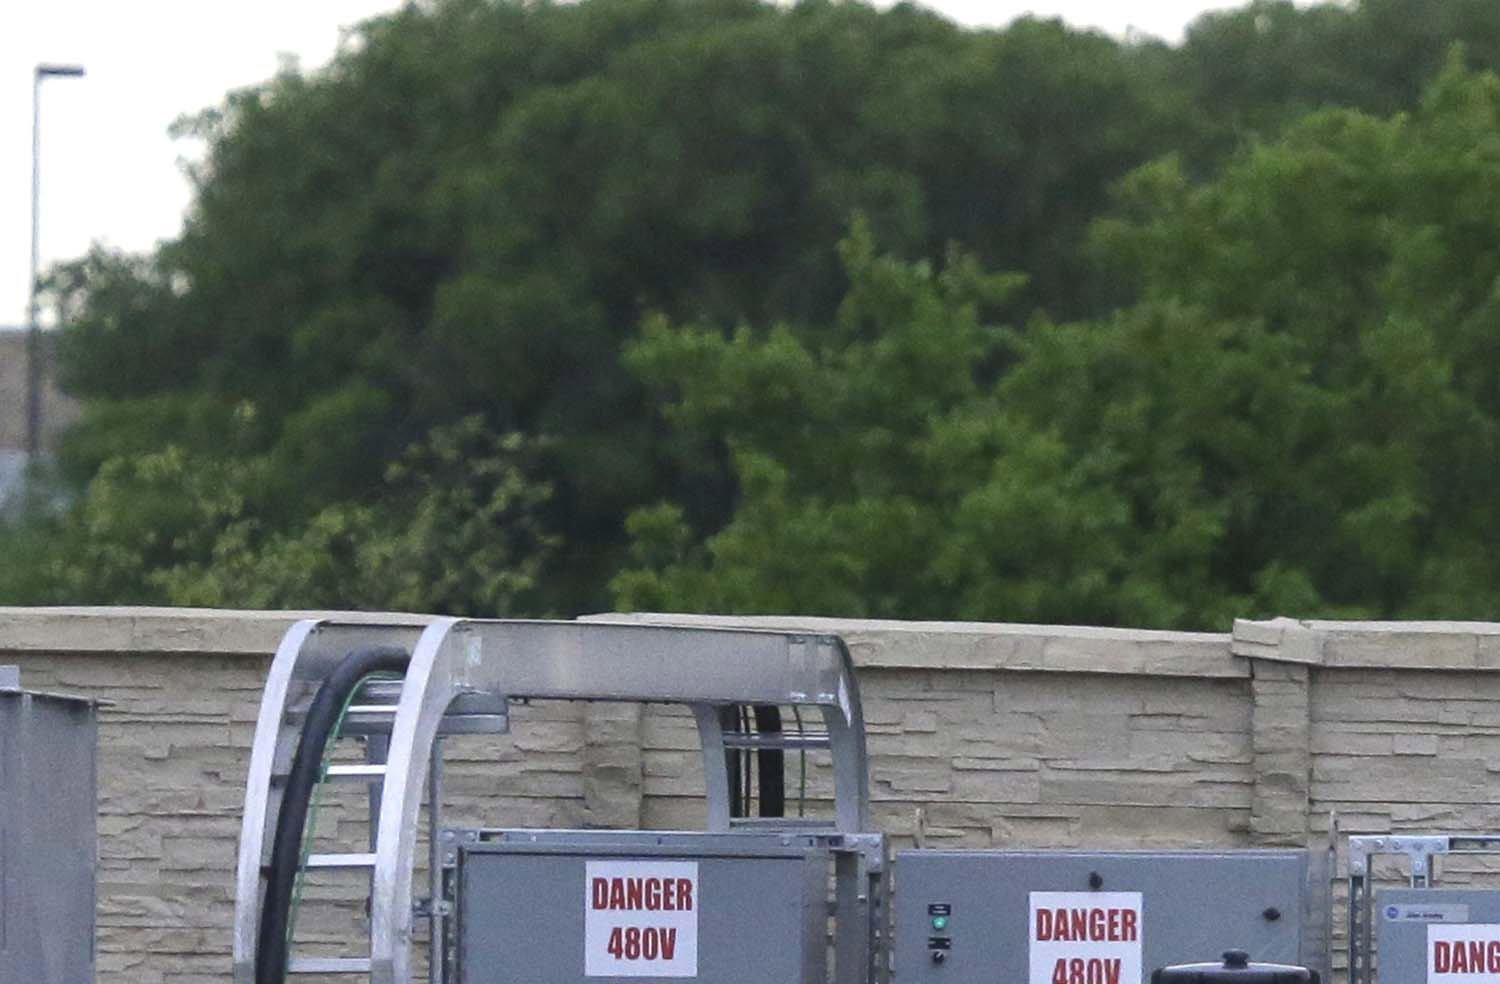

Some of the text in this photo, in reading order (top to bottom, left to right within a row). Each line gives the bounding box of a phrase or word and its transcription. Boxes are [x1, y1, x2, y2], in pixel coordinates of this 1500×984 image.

[592, 877, 693, 911] DANGER
[1036, 908, 1137, 941] DANGER
[607, 927, 676, 960] 480V
